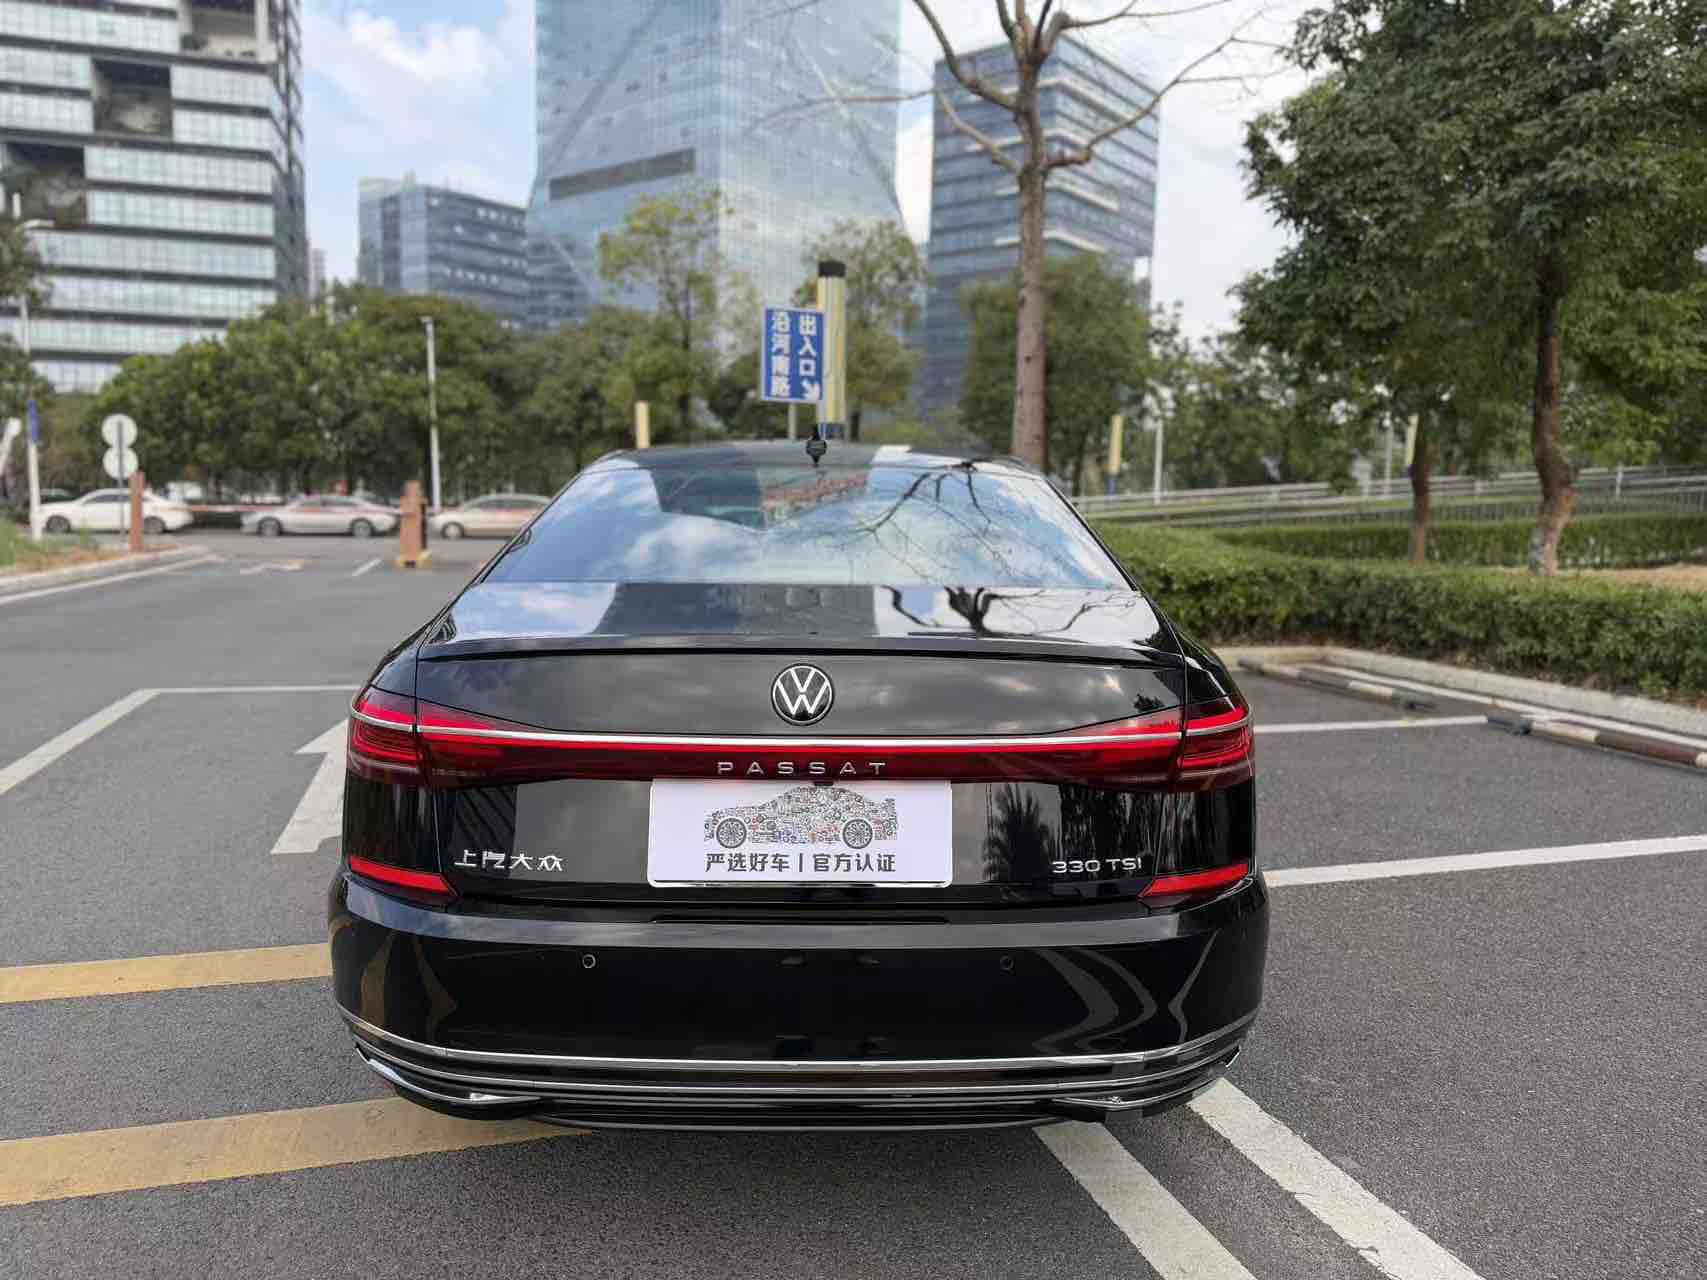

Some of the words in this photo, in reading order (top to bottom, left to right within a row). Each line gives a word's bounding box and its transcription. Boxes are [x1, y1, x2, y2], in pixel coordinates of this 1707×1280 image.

[799, 314, 817, 377] 出入口
[717, 761, 886, 775] PASSAT
[454, 849, 563, 872] 上汽大众
[705, 852, 790, 873] 严选好车
[812, 852, 897, 873] 官方认证
[1052, 860, 1101, 874] 330
[1105, 857, 1143, 872] TSI
